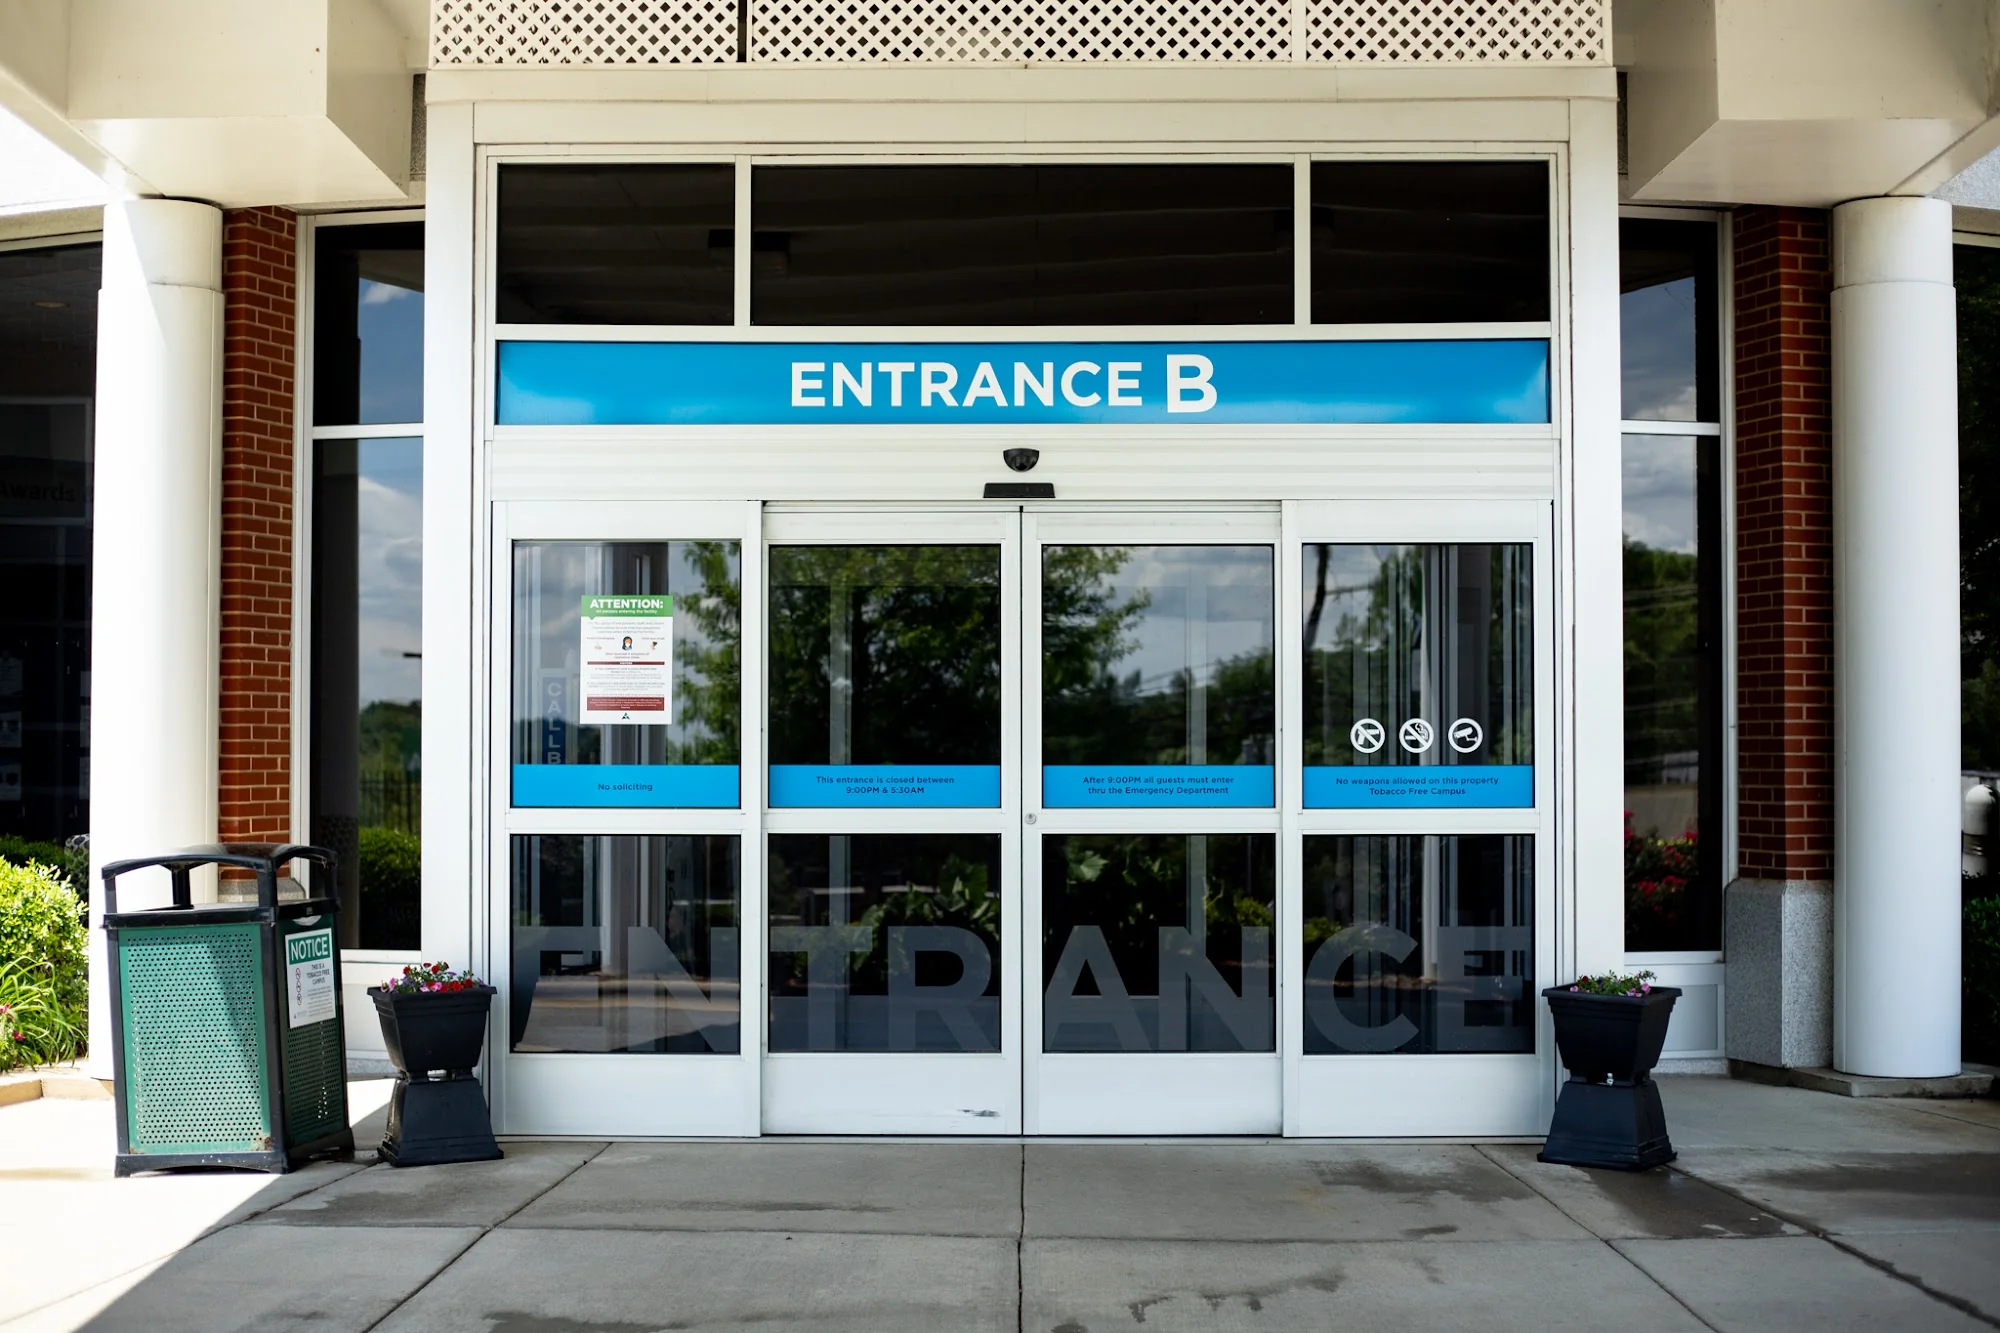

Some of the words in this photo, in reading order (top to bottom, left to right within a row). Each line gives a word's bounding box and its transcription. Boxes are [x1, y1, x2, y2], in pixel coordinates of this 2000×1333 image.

[791, 361, 1143, 408] ENTRANCE
[1166, 353, 1218, 414] B
[590, 599, 664, 609] ATTENTION:
[816, 776, 834, 784] This
[836, 776, 874, 784] entrance
[876, 776, 884, 784] is
[886, 776, 914, 784] closed
[916, 776, 955, 784] between
[1083, 776, 1105, 784] After
[1107, 776, 1141, 784] 9:00PM
[1143, 776, 1154, 784] all
[1156, 776, 1185, 786] guests
[1187, 776, 1209, 784] must
[1211, 776, 1234, 784] enter
[1336, 777, 1349, 785] No
[1351, 778, 1390, 787] weapons
[1392, 777, 1426, 785] allowed
[1442, 777, 1459, 785] this
[1460, 777, 1499, 787] property
[598, 783, 610, 791] No
[612, 783, 653, 792] soliciting
[846, 786, 880, 794] 9:00PM
[882, 786, 888, 794] &
[891, 786, 925, 794] 5:30AM
[1088, 786, 1106, 794] thru
[1108, 786, 1123, 794] the
[1125, 786, 1174, 796] Emergency
[1176, 786, 1229, 796] Department
[1369, 787, 1406, 795] Tobacco
[1409, 787, 1429, 795] Free
[1431, 787, 1466, 796] Campus
[291, 937, 328, 961] NOTICE
[514, 925, 1531, 1052] ENTRANCE
